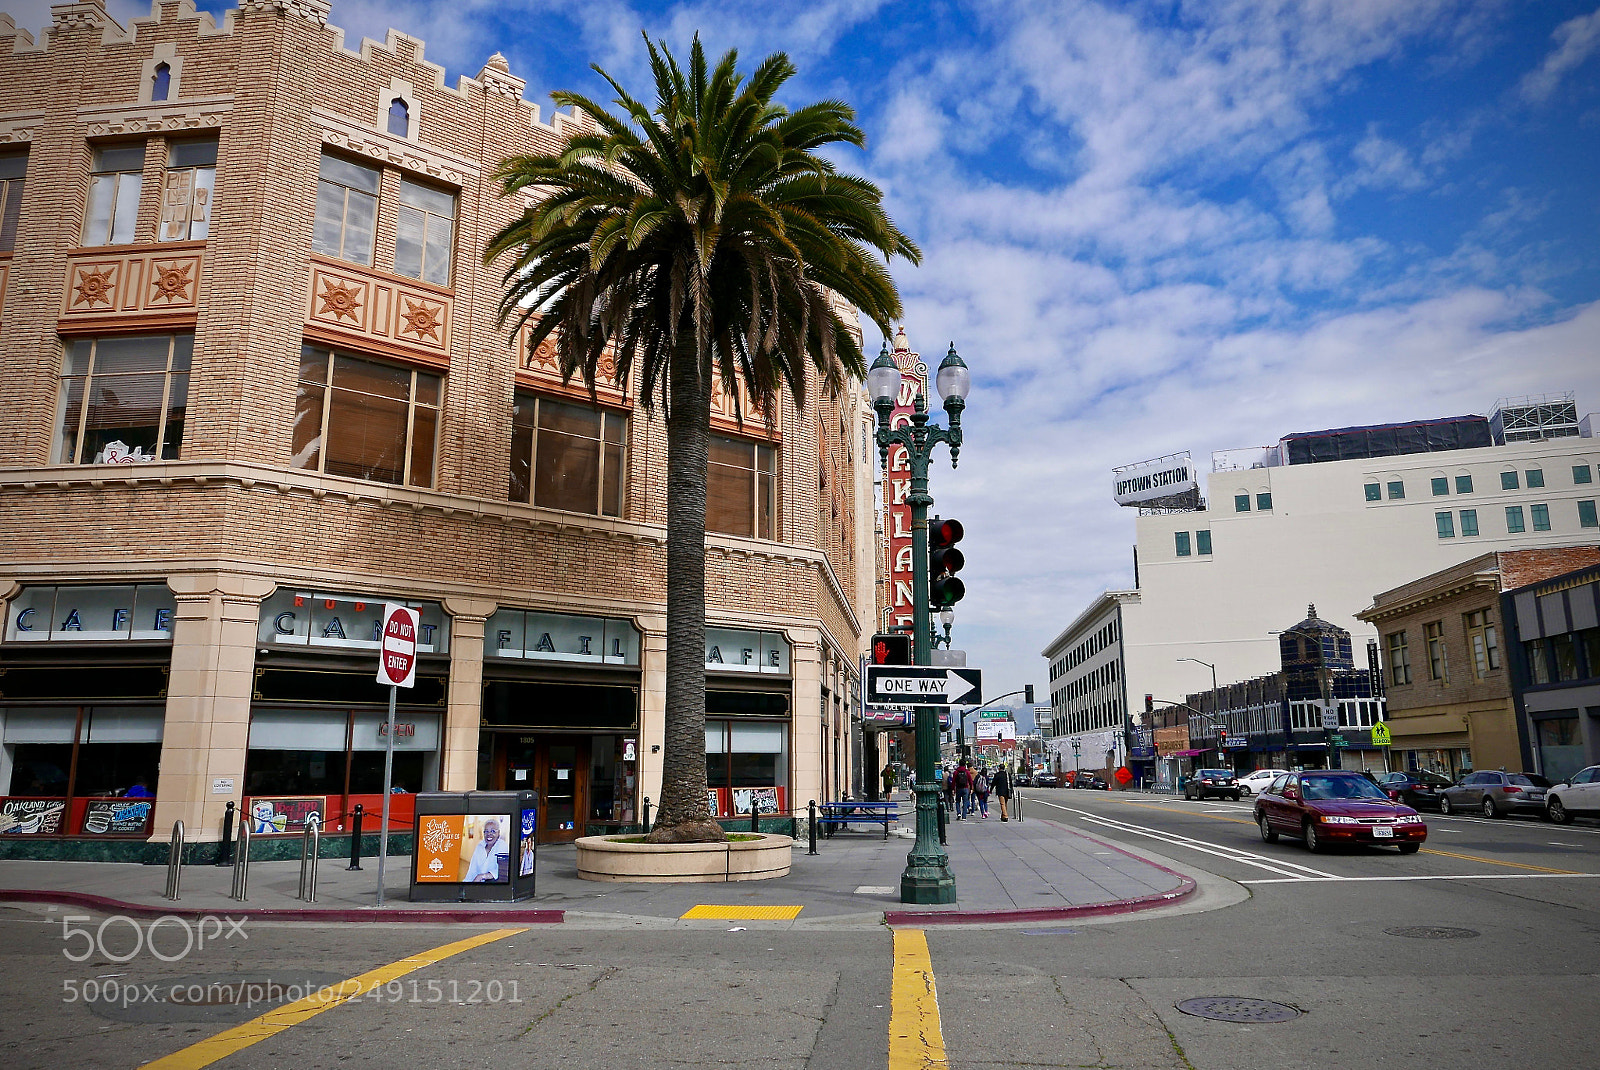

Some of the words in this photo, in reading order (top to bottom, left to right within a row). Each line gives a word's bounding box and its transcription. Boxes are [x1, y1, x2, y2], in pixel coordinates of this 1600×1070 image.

[1117, 474, 1152, 496] UPTOWN
[1152, 466, 1189, 488] STATION
[16, 607, 171, 632] CAFE
[389, 620, 399, 634] DO
[400, 623, 413, 638] NOT
[497, 629, 625, 658] FAIL
[388, 655, 408, 671] ENTER
[706, 644, 780, 668] AFE
[884, 679, 913, 692] ONE
[918, 680, 947, 692] WAY
[4, 801, 46, 815] OAKLAND
